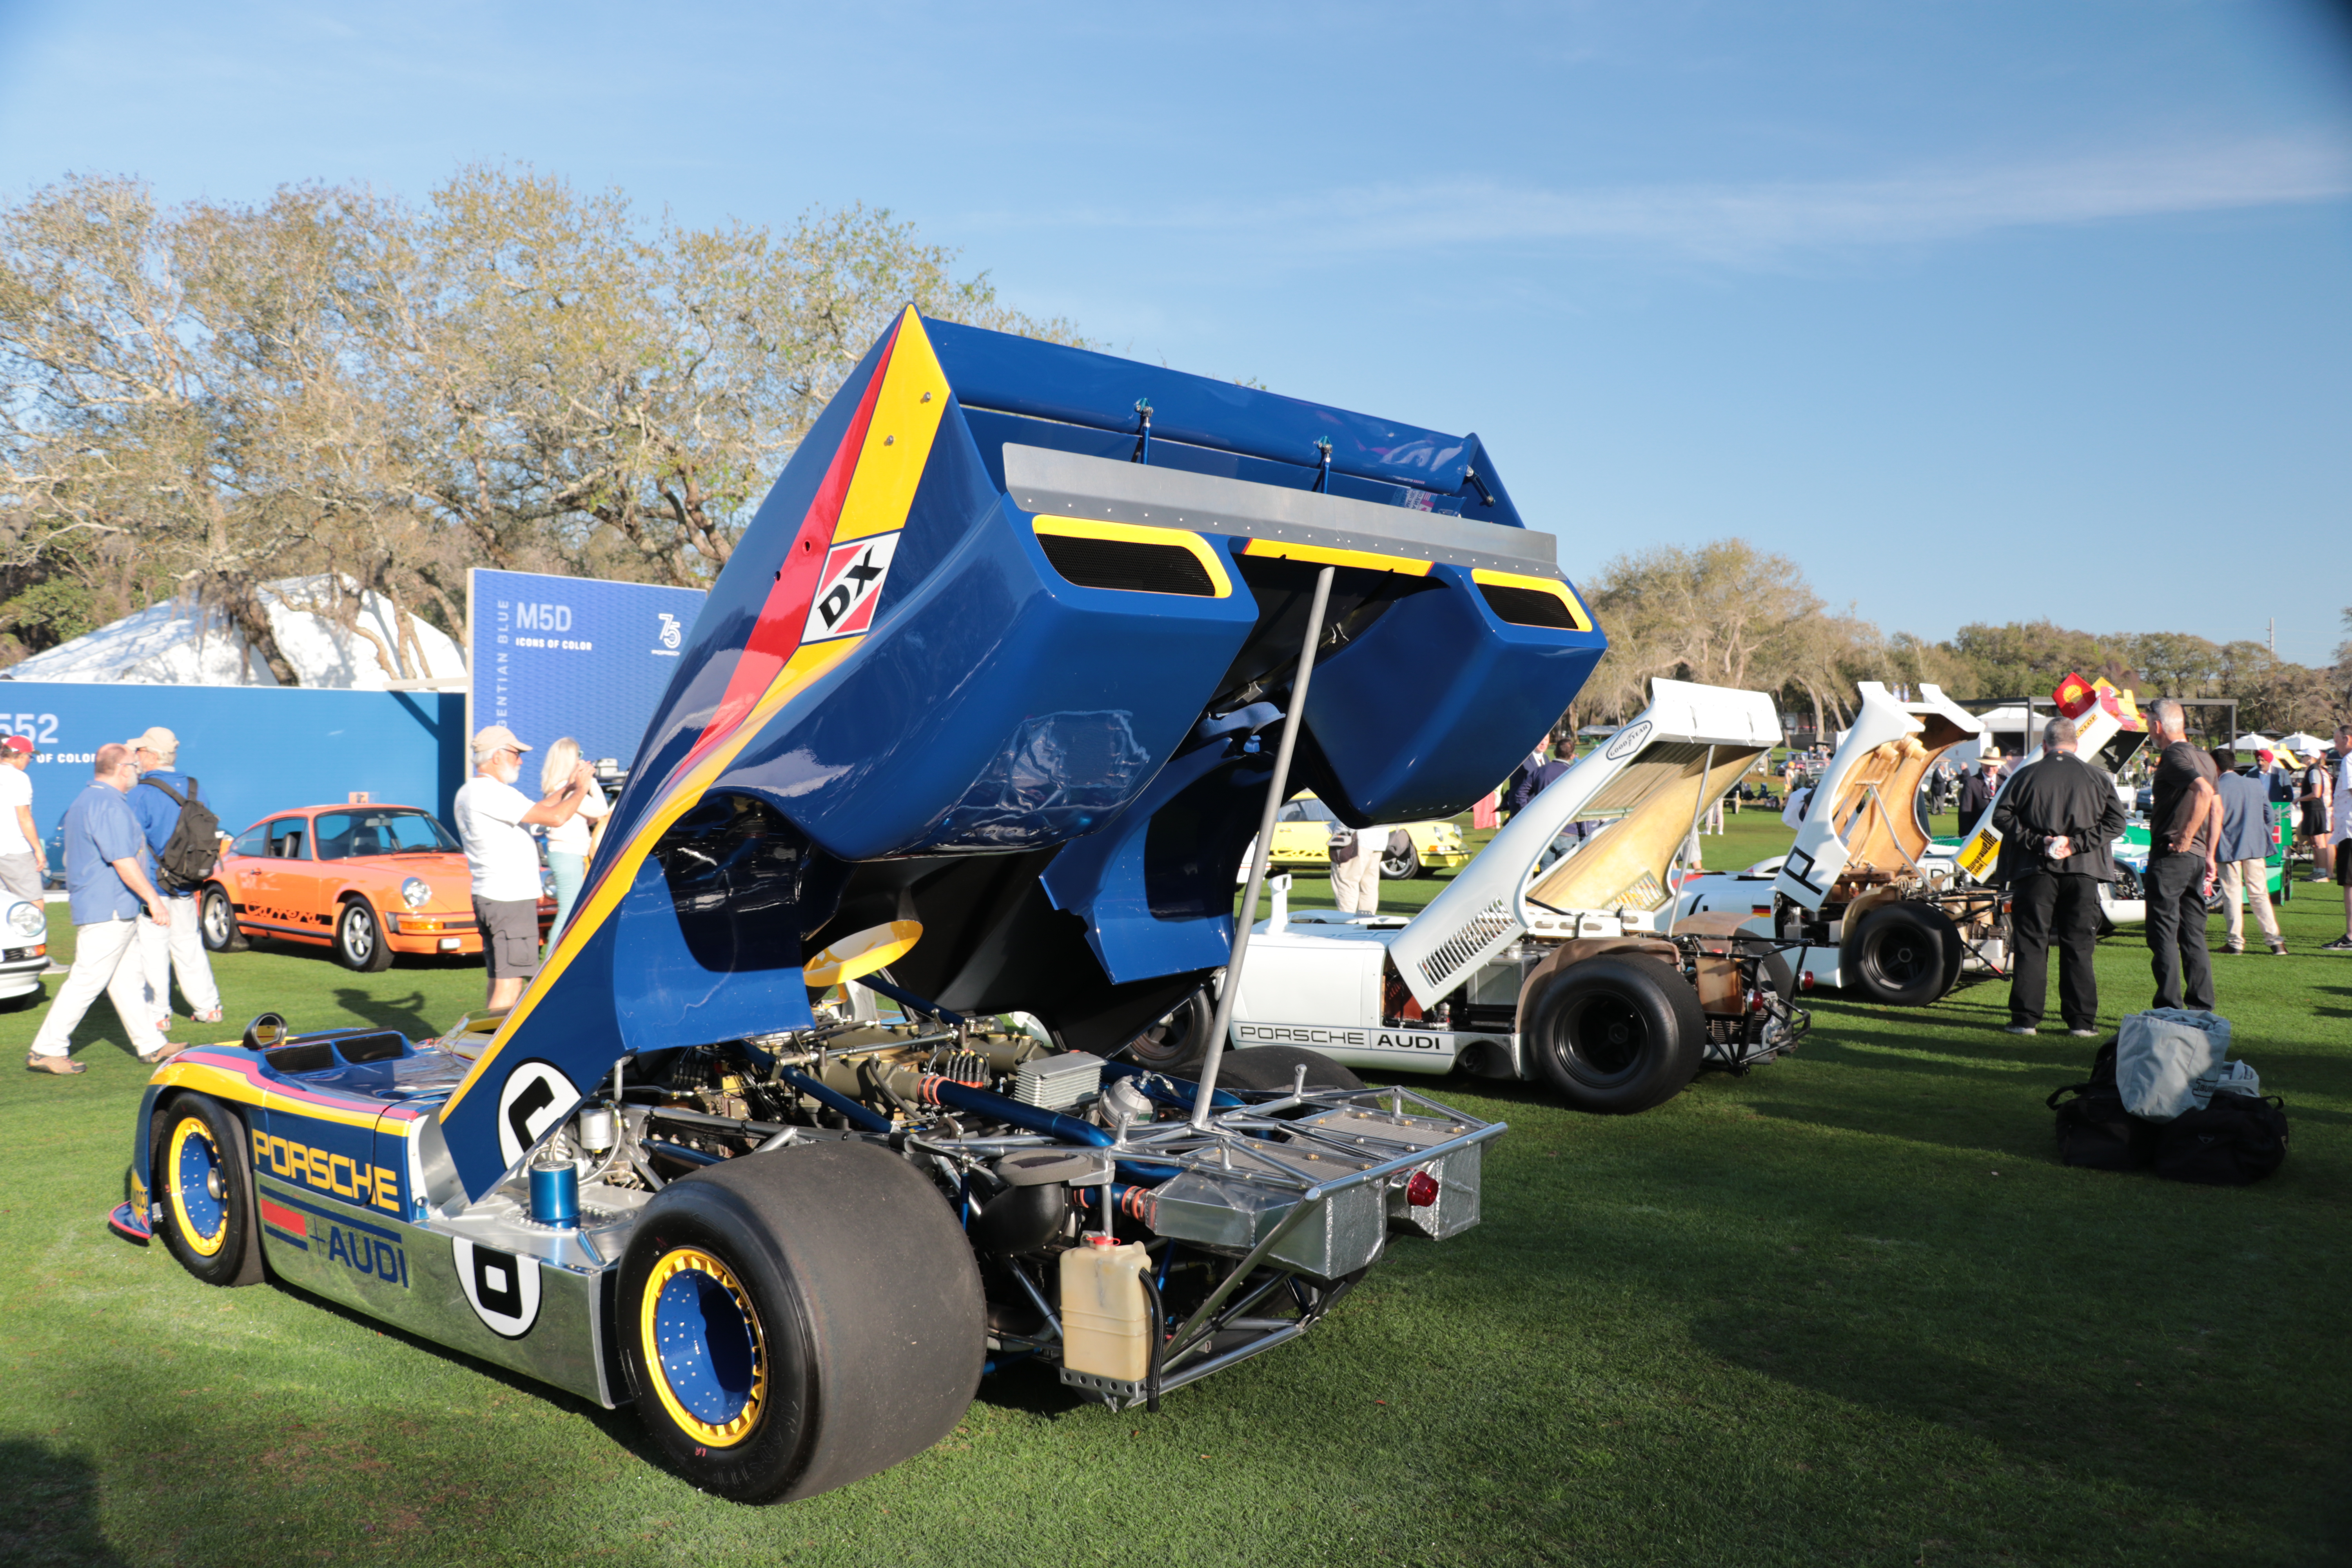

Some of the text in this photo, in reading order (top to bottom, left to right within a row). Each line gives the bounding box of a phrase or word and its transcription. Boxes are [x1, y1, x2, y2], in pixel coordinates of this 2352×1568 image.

[818, 544, 885, 631] DX
[516, 602, 572, 632] M5D
[515, 637, 592, 650] ICONS OF COLOR
[496, 600, 509, 729] GENTIAN BLUE
[36, 754, 53, 763] OF
[244, 901, 322, 925] Carrera
[1240, 1026, 1440, 1050] PORSCHE AUDI
[252, 1128, 400, 1212] PORSCHE
